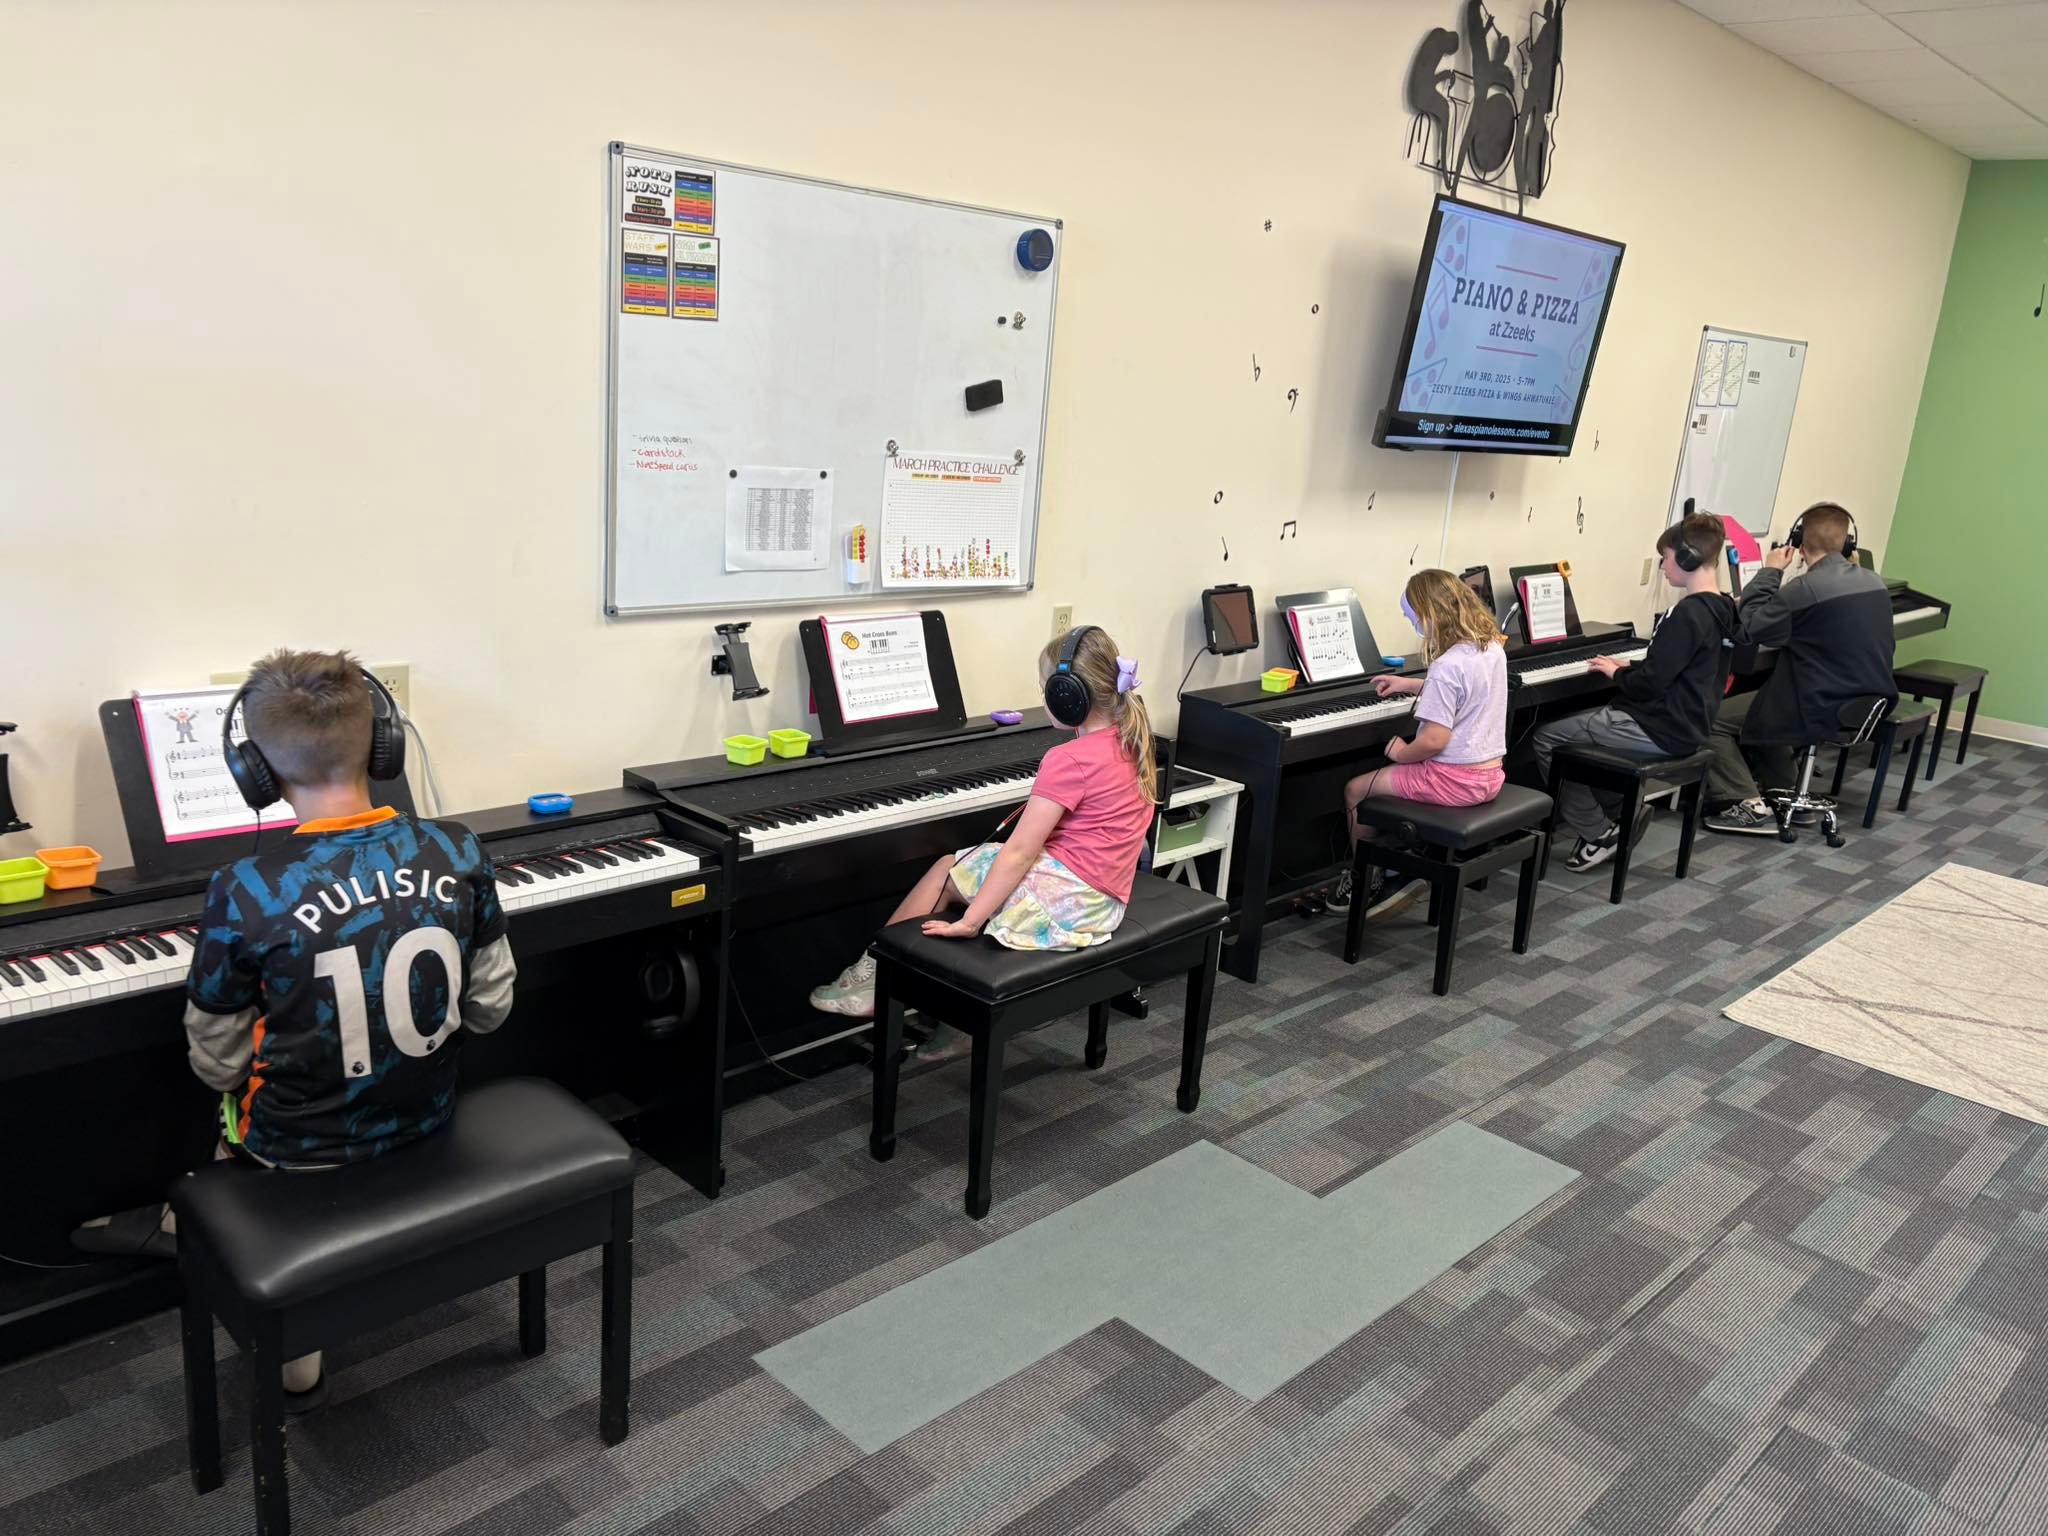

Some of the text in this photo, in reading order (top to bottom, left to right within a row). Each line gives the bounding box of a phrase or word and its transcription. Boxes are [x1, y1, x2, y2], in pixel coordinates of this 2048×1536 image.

[625, 166, 672, 183] NOTE
[625, 181, 672, 197] RUSH
[624, 242, 653, 252] WARS
[1452, 277, 1580, 325] PIANO & PIZZA
[1489, 322, 1536, 342] at Zzeeks
[1464, 370, 1536, 386] MAY 3RD, 2025 5-7PM
[1432, 383, 1452, 394] ZESTY
[1453, 386, 1476, 397] ZZEEKS
[1478, 389, 1495, 399] PIZZA
[1502, 391, 1522, 401] WINGS
[1417, 418, 1551, 440] Sign up alexaspianolessons.com/events
[893, 457, 1020, 476] MARCH PRACTICE CHALLENGE
[292, 868, 458, 934] PULISIC
[313, 926, 462, 1079] 10
